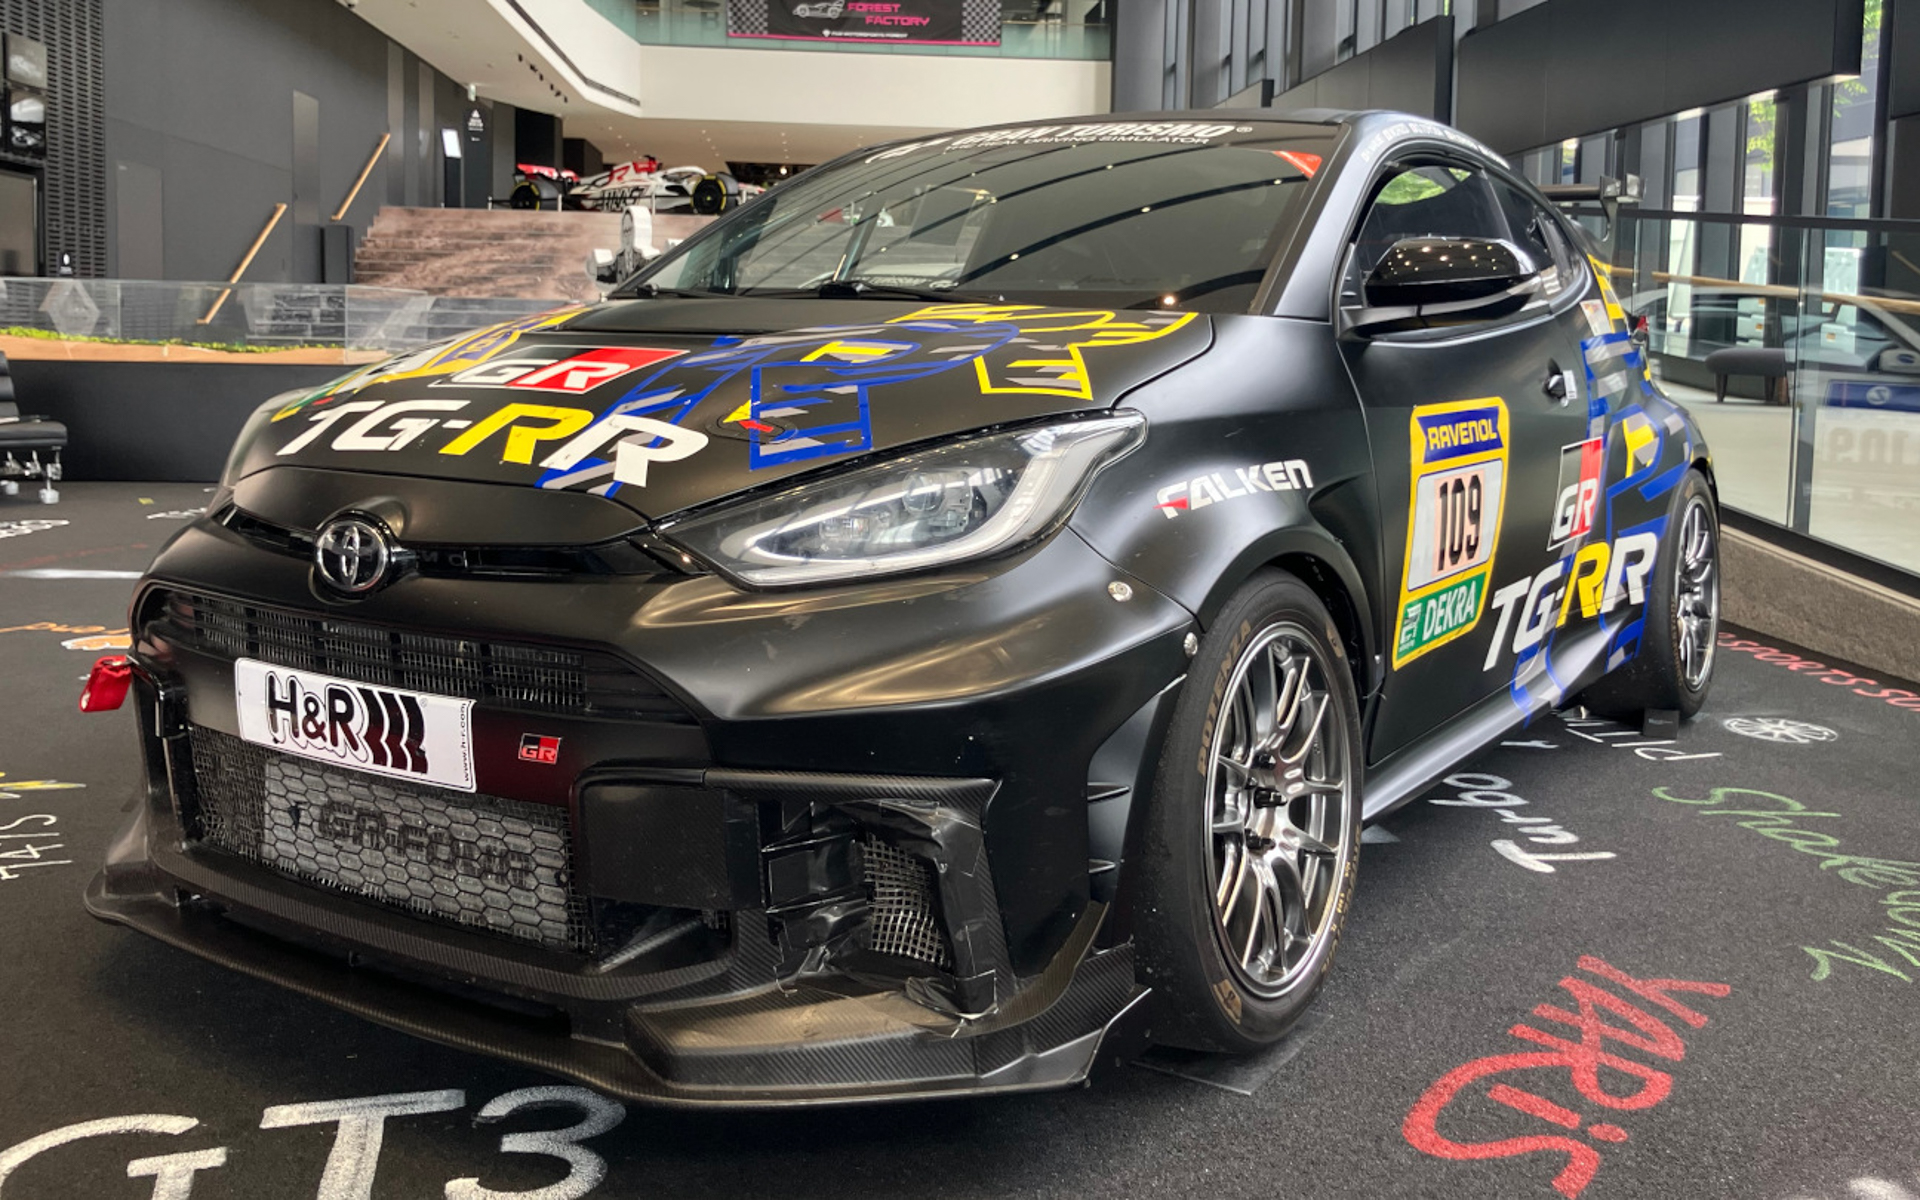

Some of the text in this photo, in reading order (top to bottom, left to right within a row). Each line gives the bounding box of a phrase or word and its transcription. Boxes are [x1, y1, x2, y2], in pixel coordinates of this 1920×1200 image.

[847, 2, 901, 13] FOREST
[865, 16, 930, 26] FACTORY
[951, 122, 1236, 146] GRAN TURISMO
[1023, 136, 1096, 145] DRIVING
[1099, 135, 1210, 145] SIMULATOR
[451, 358, 632, 390] GR
[1427, 418, 1498, 450] RAVENOL
[1153, 459, 1314, 520] FALKEN
[1553, 478, 1599, 541] GR
[1437, 474, 1482, 571] 109
[1422, 580, 1476, 642] DEKRA
[267, 672, 364, 757] H&R
[1197, 619, 1252, 777] POTENZA
[521, 746, 558, 763] GR
[1428, 772, 1617, 873] Turbo
